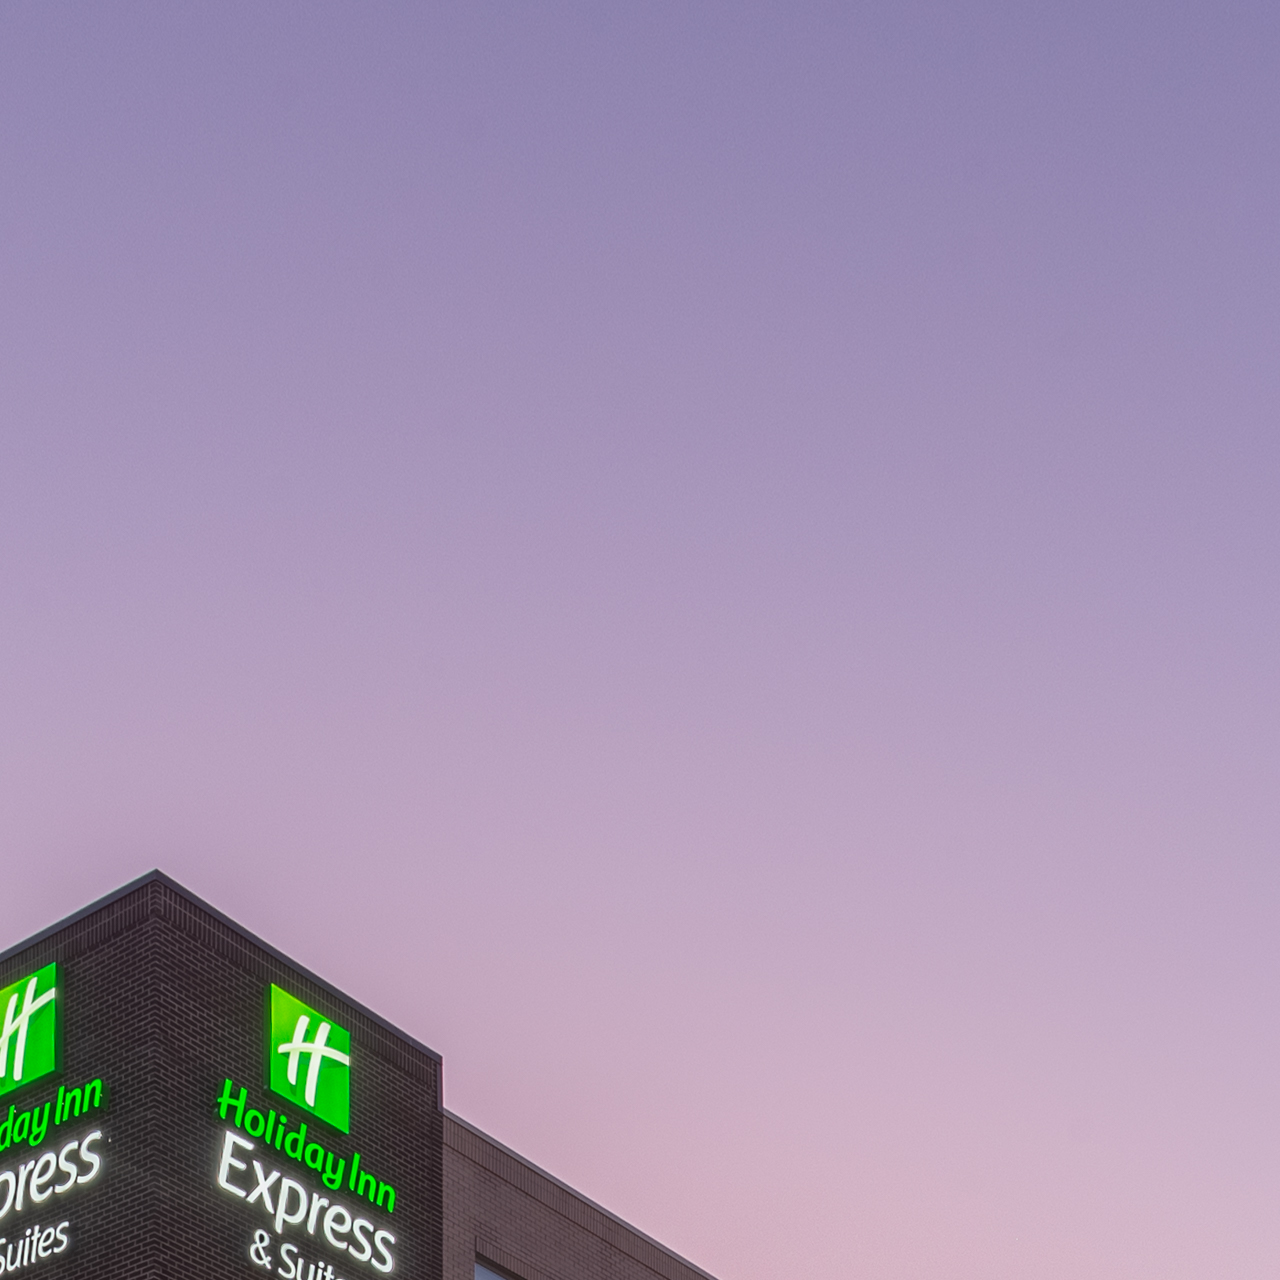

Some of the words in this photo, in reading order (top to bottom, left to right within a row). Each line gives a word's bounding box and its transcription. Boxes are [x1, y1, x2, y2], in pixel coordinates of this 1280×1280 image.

[54, 1078, 103, 1126] Inn
[217, 1078, 346, 1191] Holiday
[348, 1152, 396, 1213] Inn
[217, 1130, 396, 1274] Express
[249, 1228, 272, 1270] &
